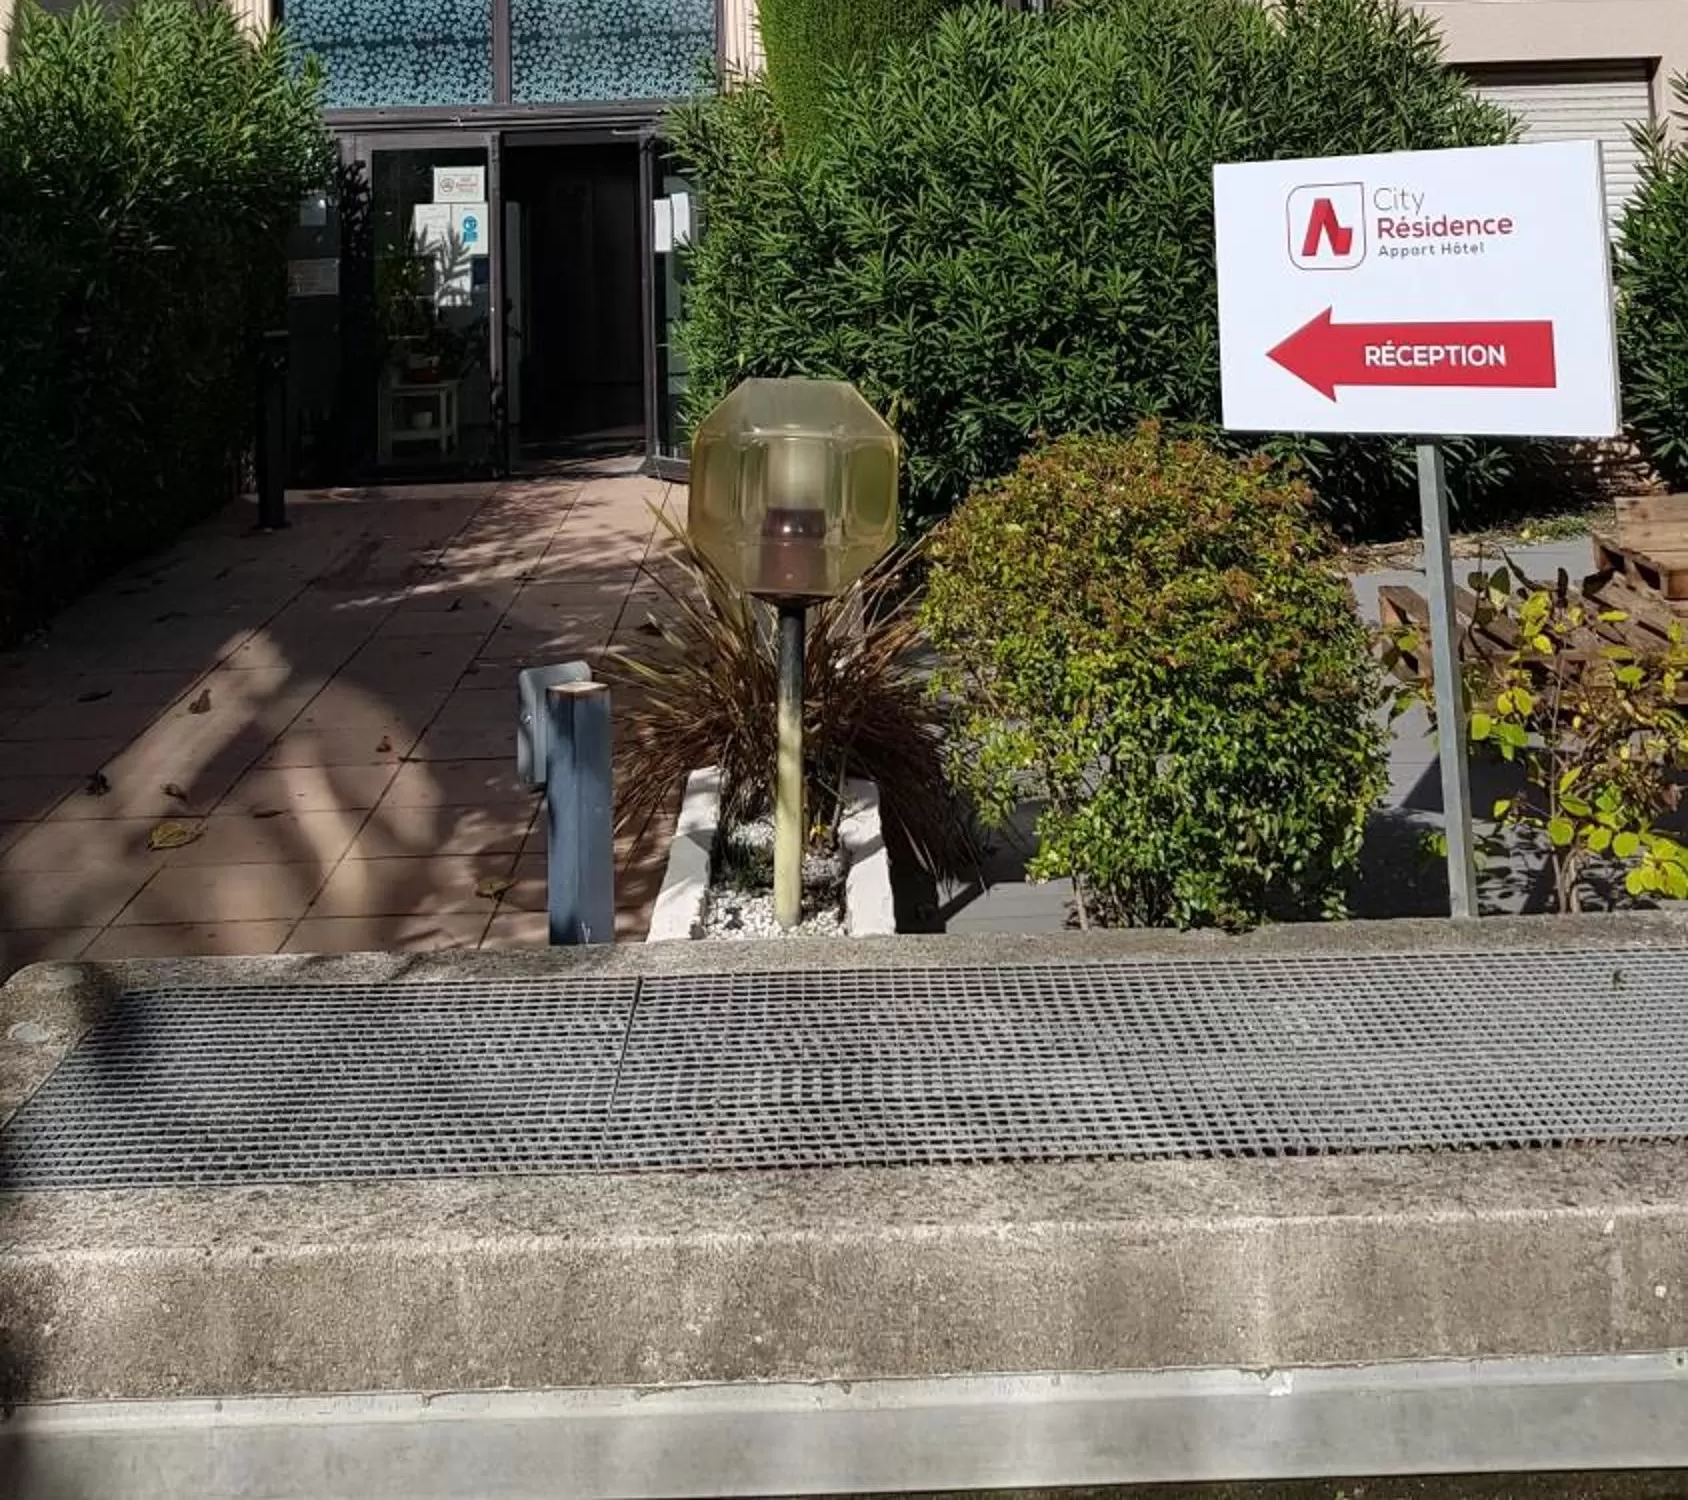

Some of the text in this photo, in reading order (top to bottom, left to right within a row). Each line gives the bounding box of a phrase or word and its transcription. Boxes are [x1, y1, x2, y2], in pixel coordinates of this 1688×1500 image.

[1373, 187, 1425, 215] City
[1377, 215, 1513, 239] Résidence
[1378, 241, 1485, 259] Appart Hôtel
[1364, 339, 1506, 367] RÉCEPTION
